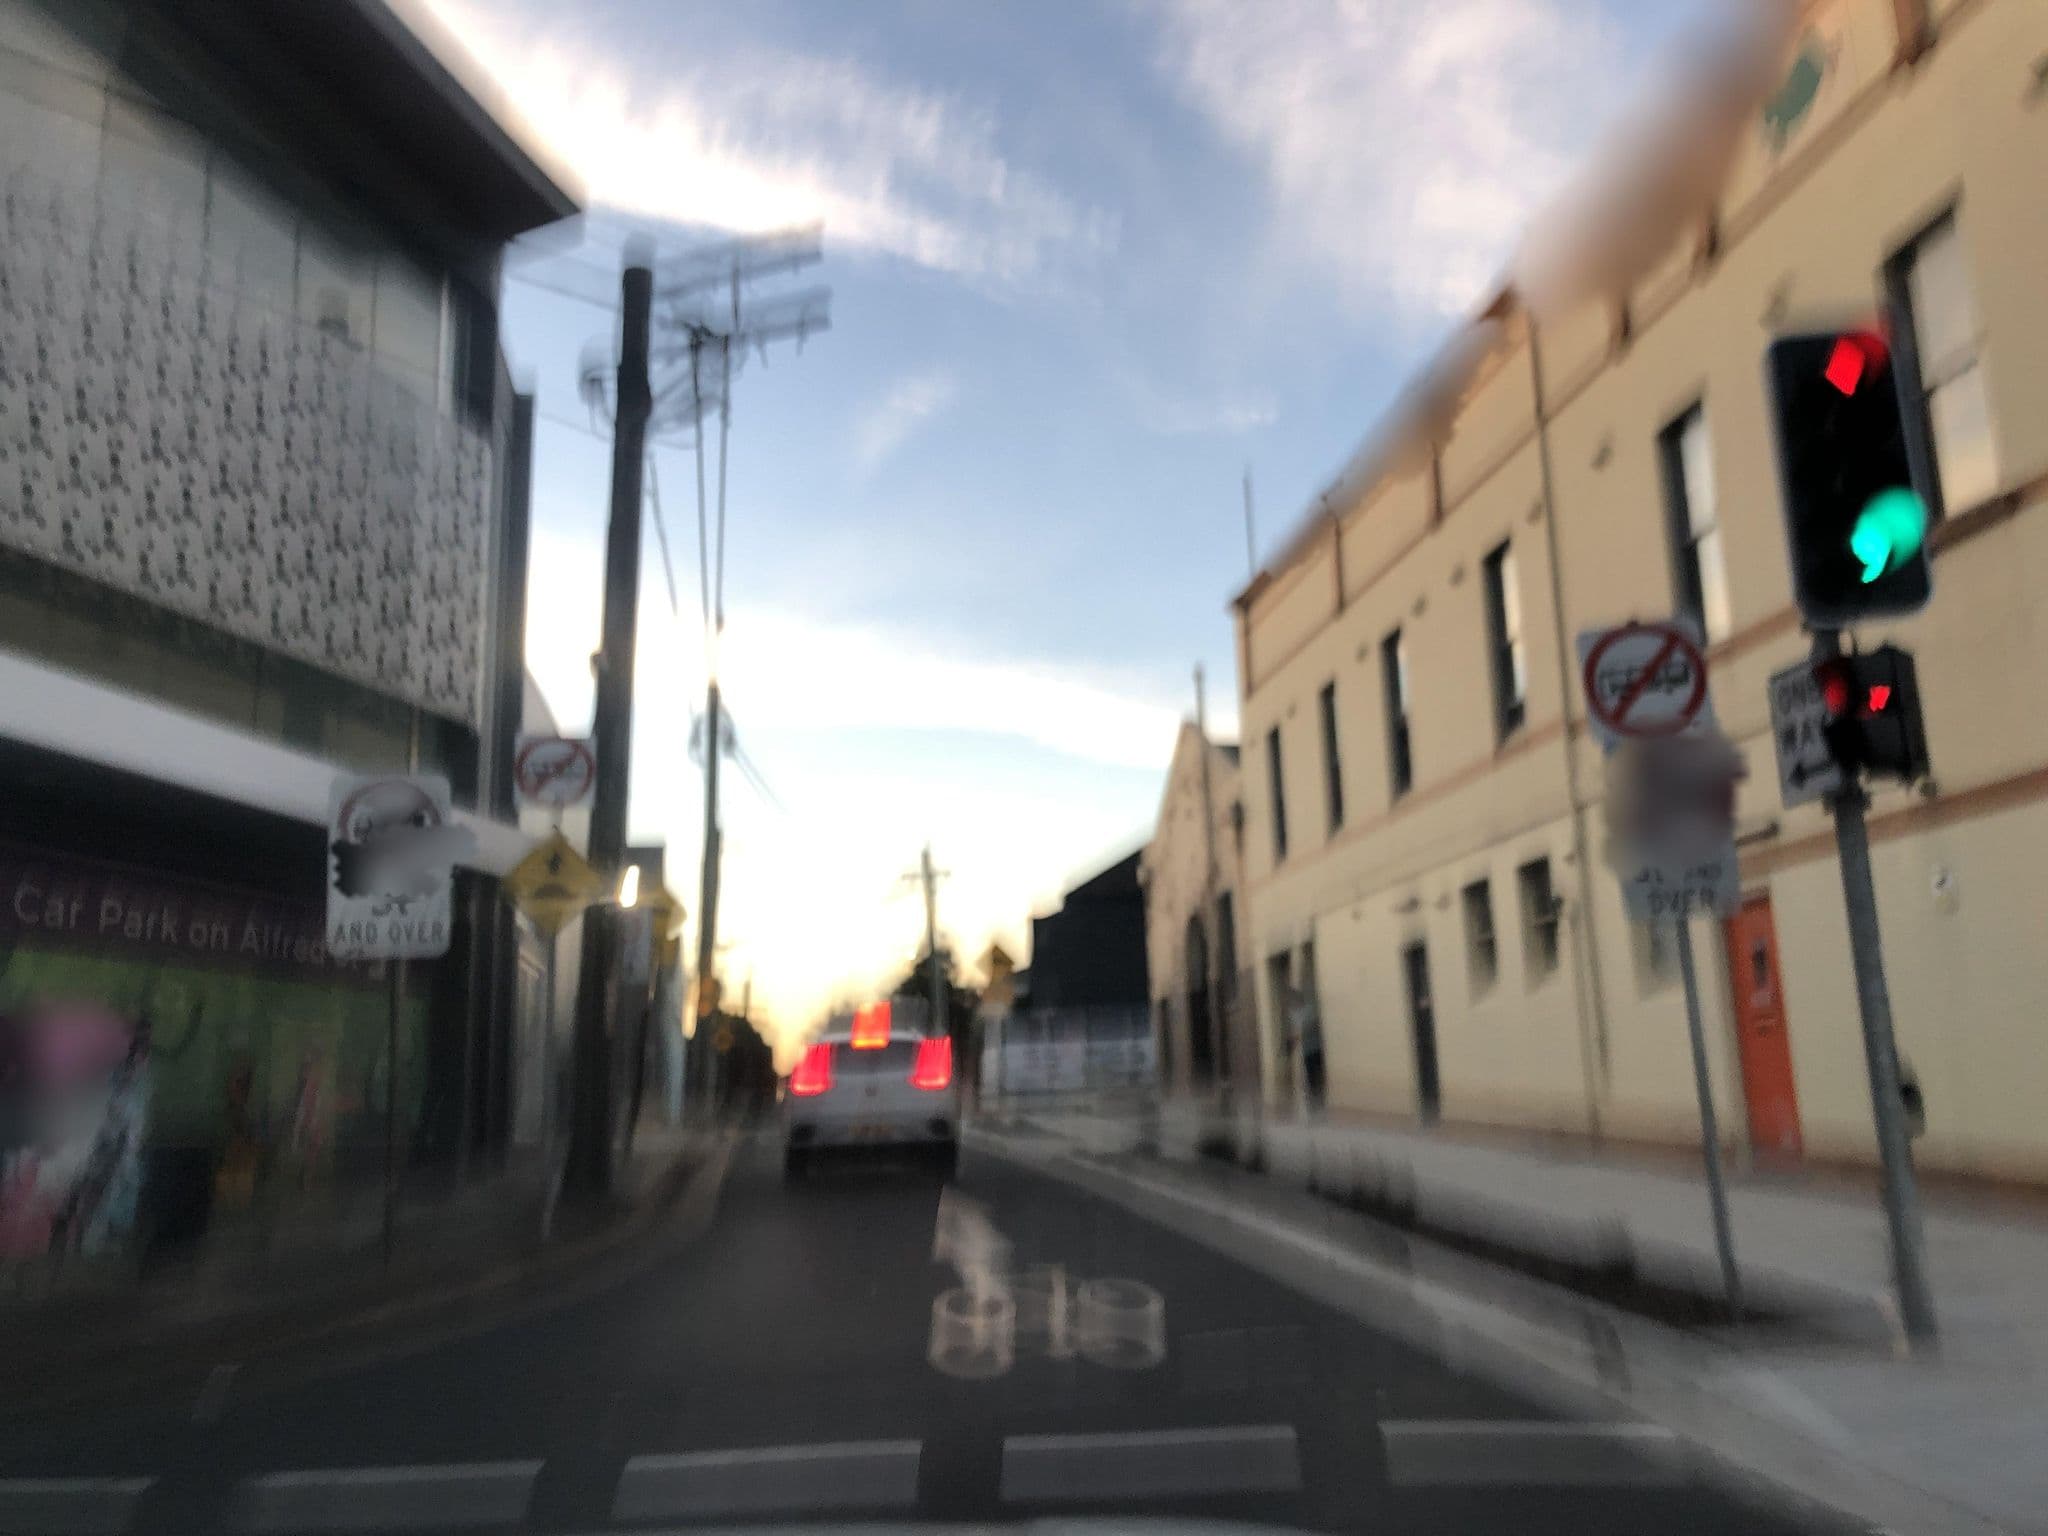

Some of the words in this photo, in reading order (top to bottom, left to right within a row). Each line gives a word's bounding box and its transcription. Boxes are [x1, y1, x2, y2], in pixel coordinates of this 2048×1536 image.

[13, 880, 82, 930] Car
[100, 894, 179, 945] Park
[188, 918, 230, 951] on
[334, 918, 378, 945] AND
[387, 918, 444, 944] OVER
